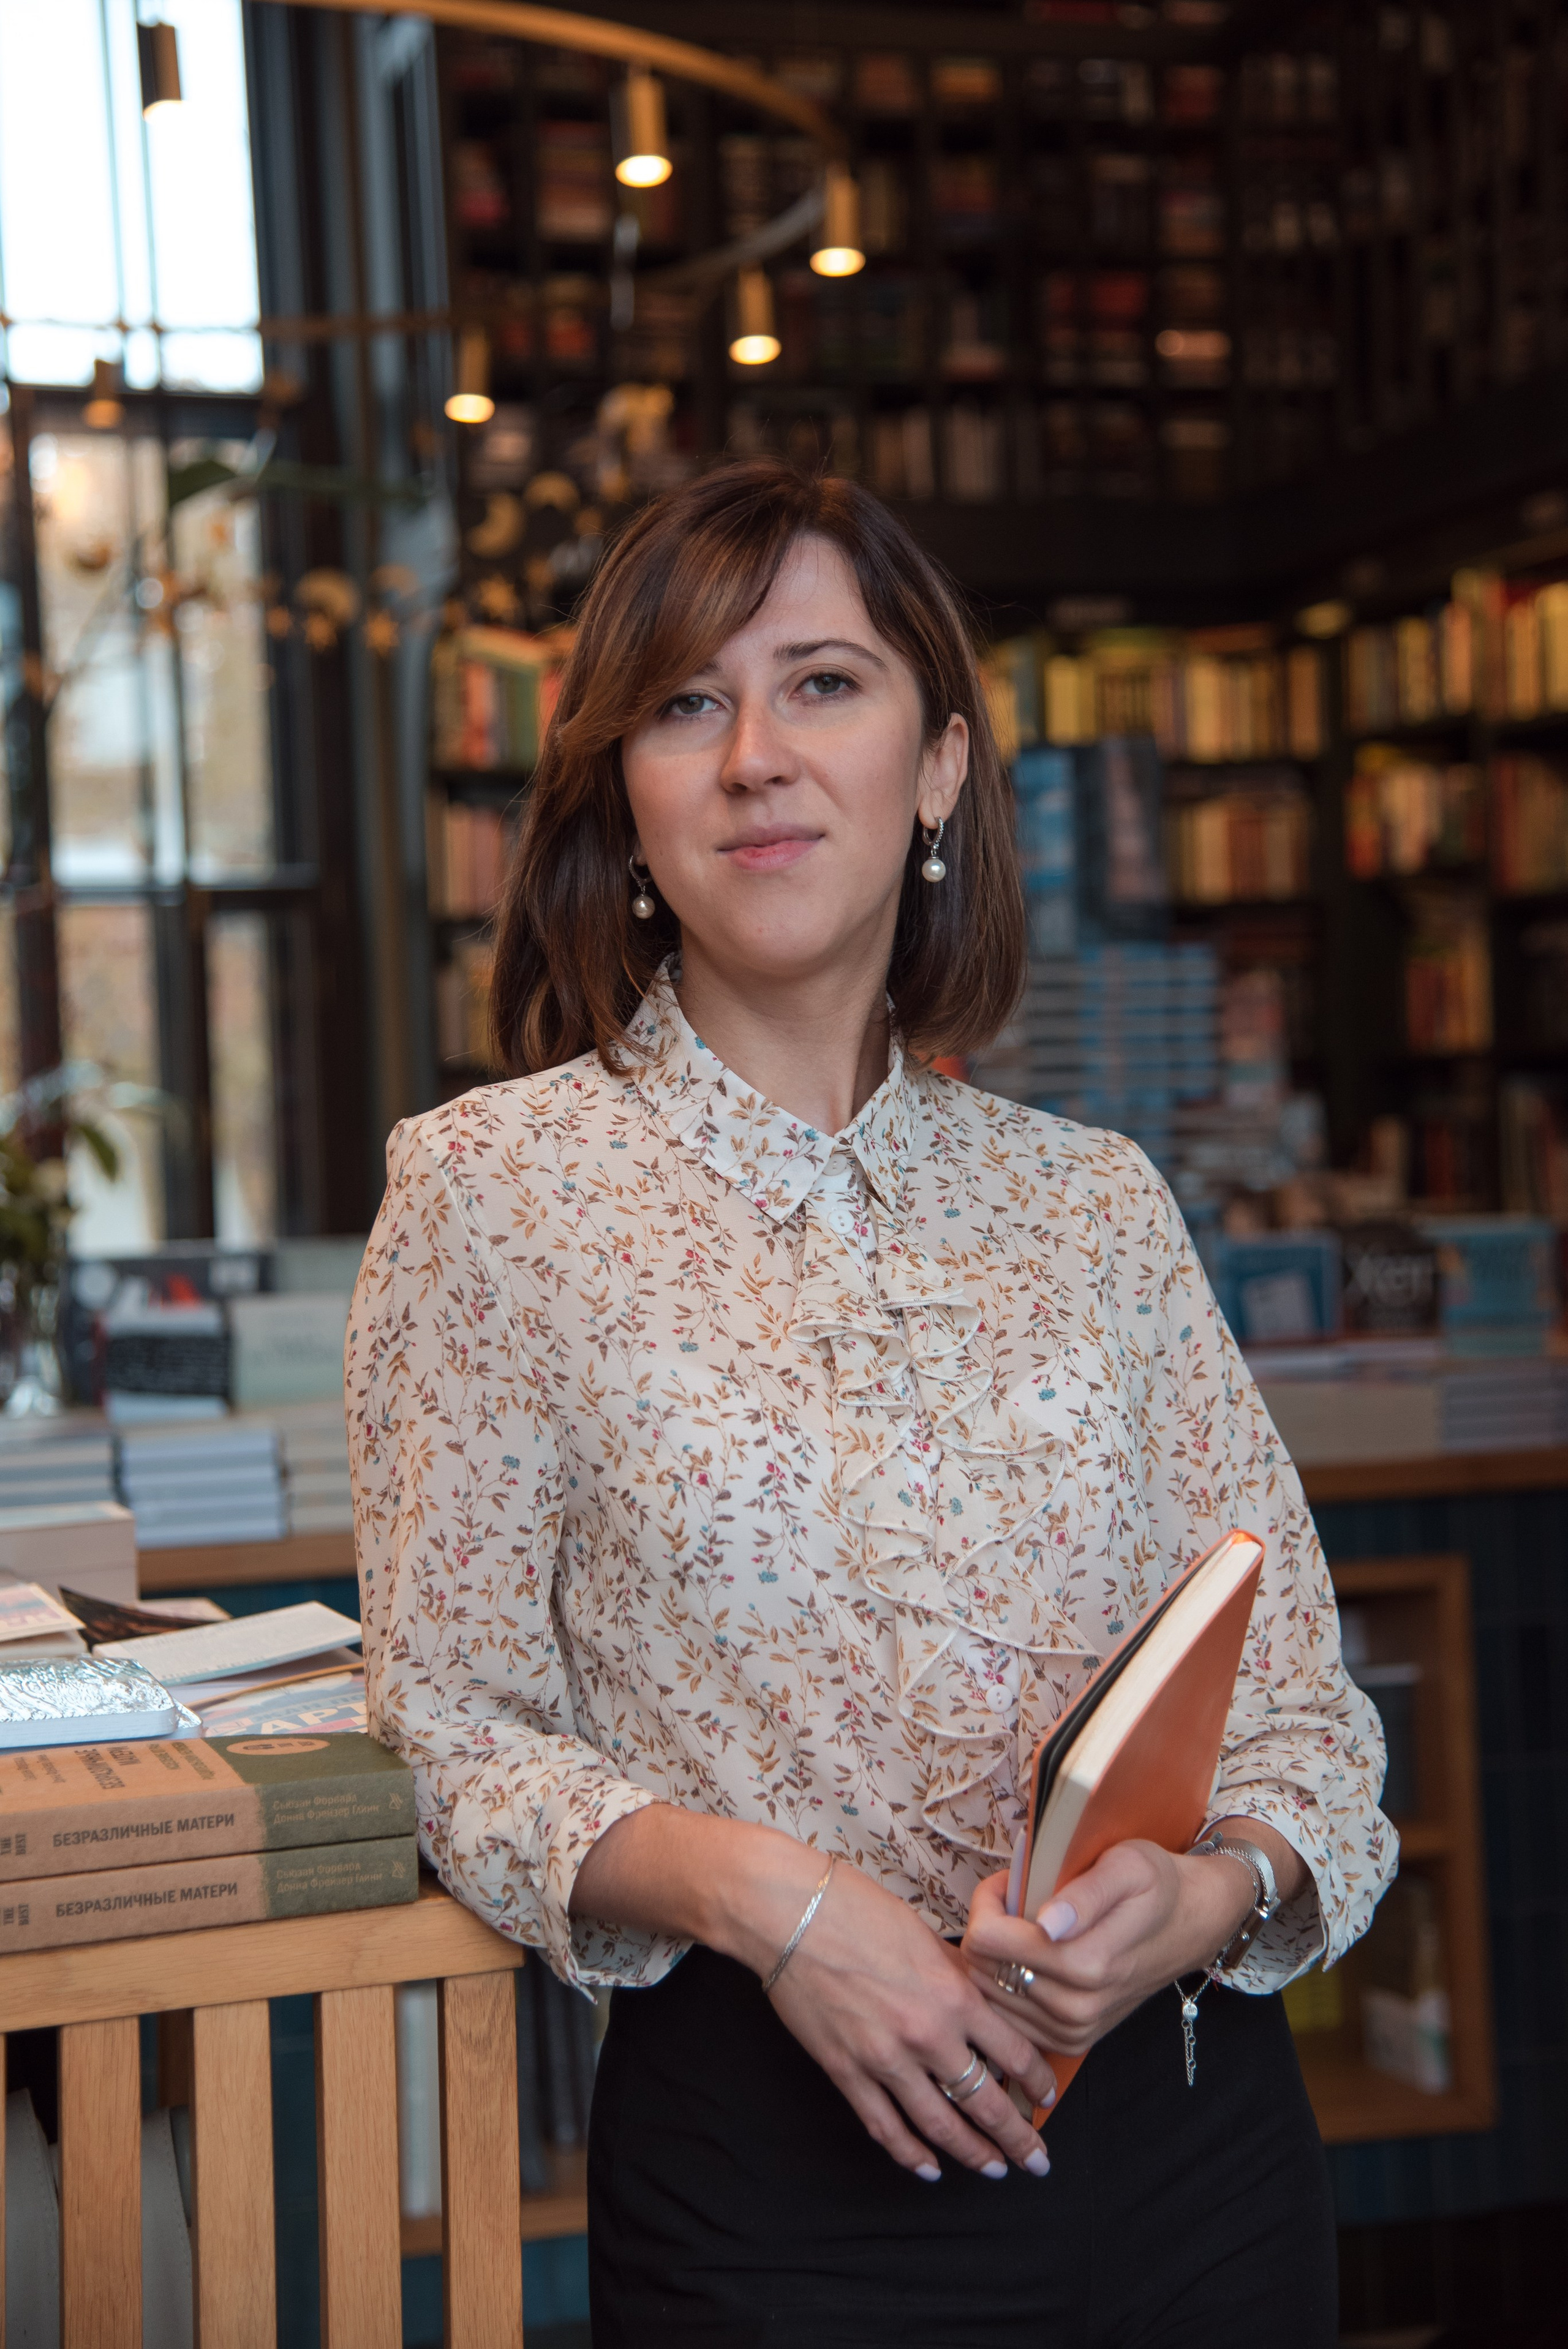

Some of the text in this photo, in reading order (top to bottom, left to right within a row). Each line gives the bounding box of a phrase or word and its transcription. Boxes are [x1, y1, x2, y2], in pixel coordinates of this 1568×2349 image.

[53, 1813, 235, 1847] БЕЗРАЗЛИЧНЫЕ МАТЕРИ
[273, 1813, 305, 1825] Донна
[15, 1833, 26, 1856] BEST
[276, 1881, 307, 1893] Донна
[56, 1882, 238, 1917] БЕЗРАЗЛИЧНЫЕ МАТЕРИ
[3, 1907, 14, 1925] THE
[18, 1903, 29, 1926] BEST
